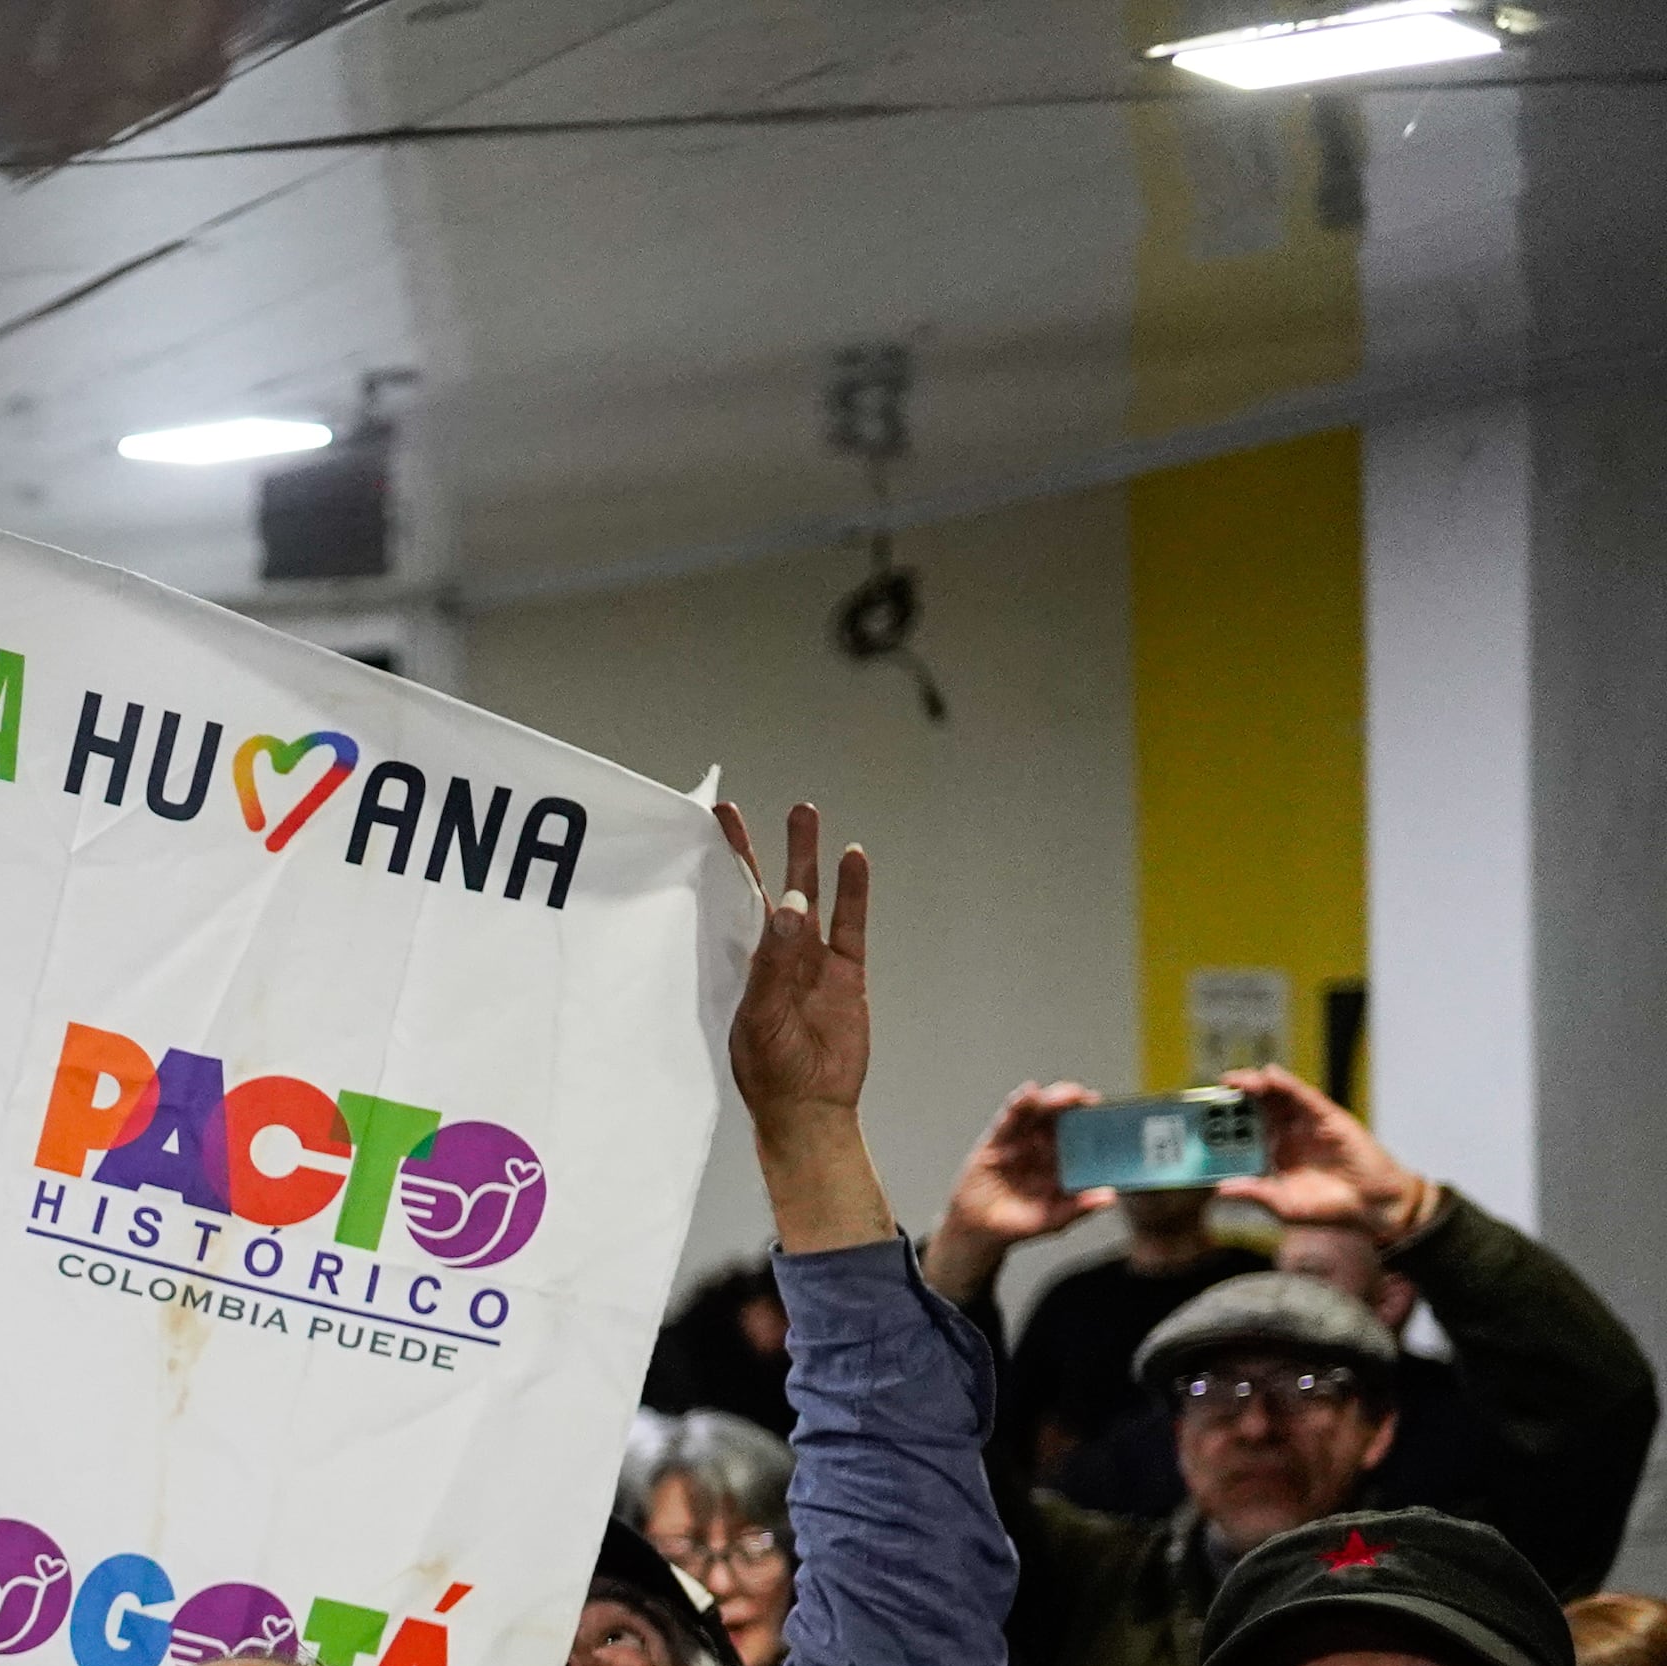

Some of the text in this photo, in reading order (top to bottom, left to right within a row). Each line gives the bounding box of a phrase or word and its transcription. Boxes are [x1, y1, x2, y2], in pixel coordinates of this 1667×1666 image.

[34, 1021, 547, 1269] PACTO
[30, 1180, 510, 1331] HISTÓRICO
[57, 1253, 460, 1371] COLOMBIA PUEDE
